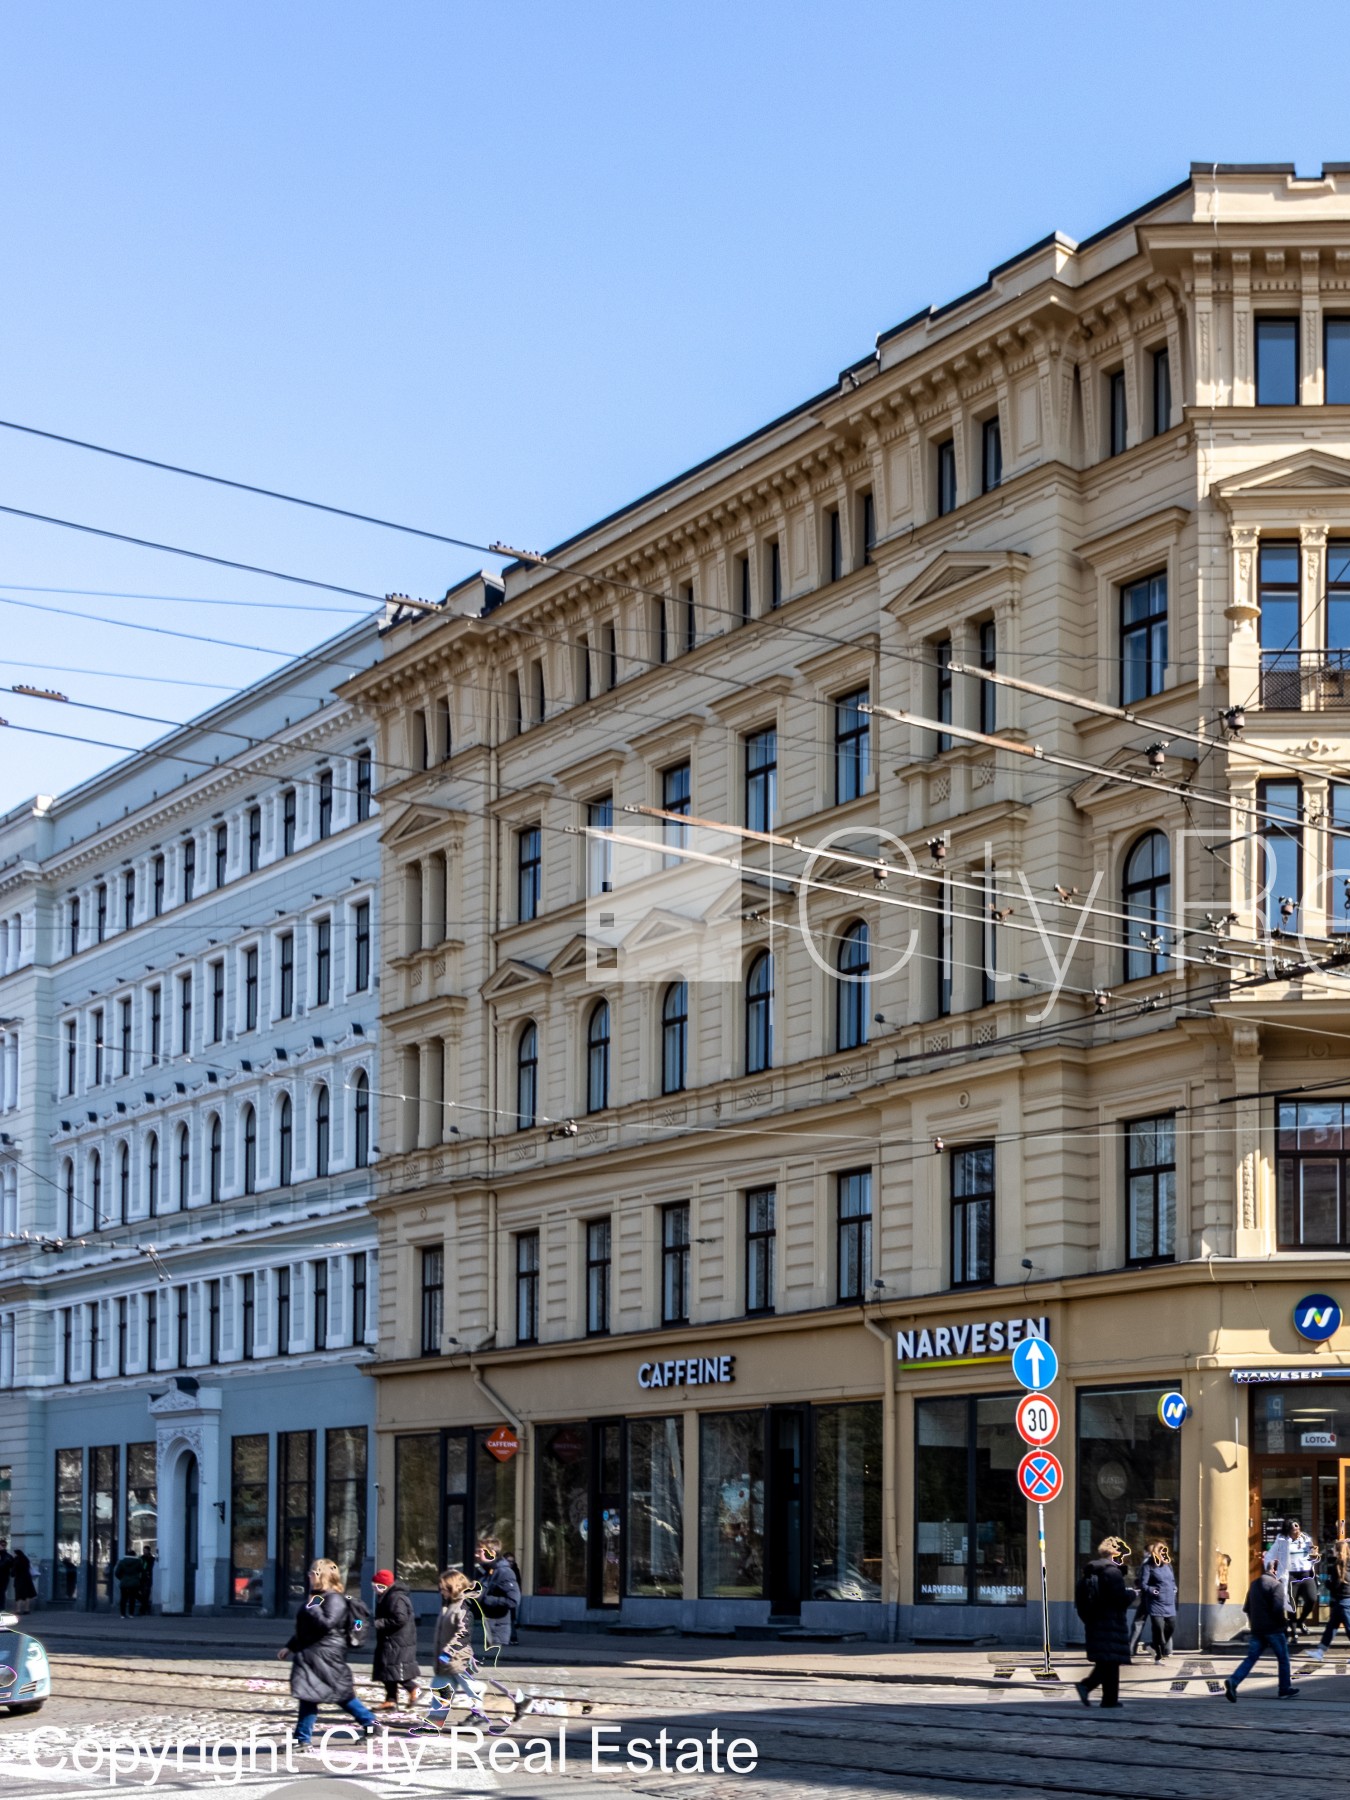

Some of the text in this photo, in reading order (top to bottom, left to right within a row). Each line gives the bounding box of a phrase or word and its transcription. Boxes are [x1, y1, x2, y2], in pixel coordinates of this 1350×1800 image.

[897, 1317, 1046, 1360] NARVESEN
[637, 1355, 733, 1388] CAFFEINE
[1237, 1371, 1323, 1383] NARVESEN
[1028, 1408, 1048, 1432] 30
[921, 1584, 963, 1595] NARVESEN
[980, 1585, 1024, 1595] NARVESEN
